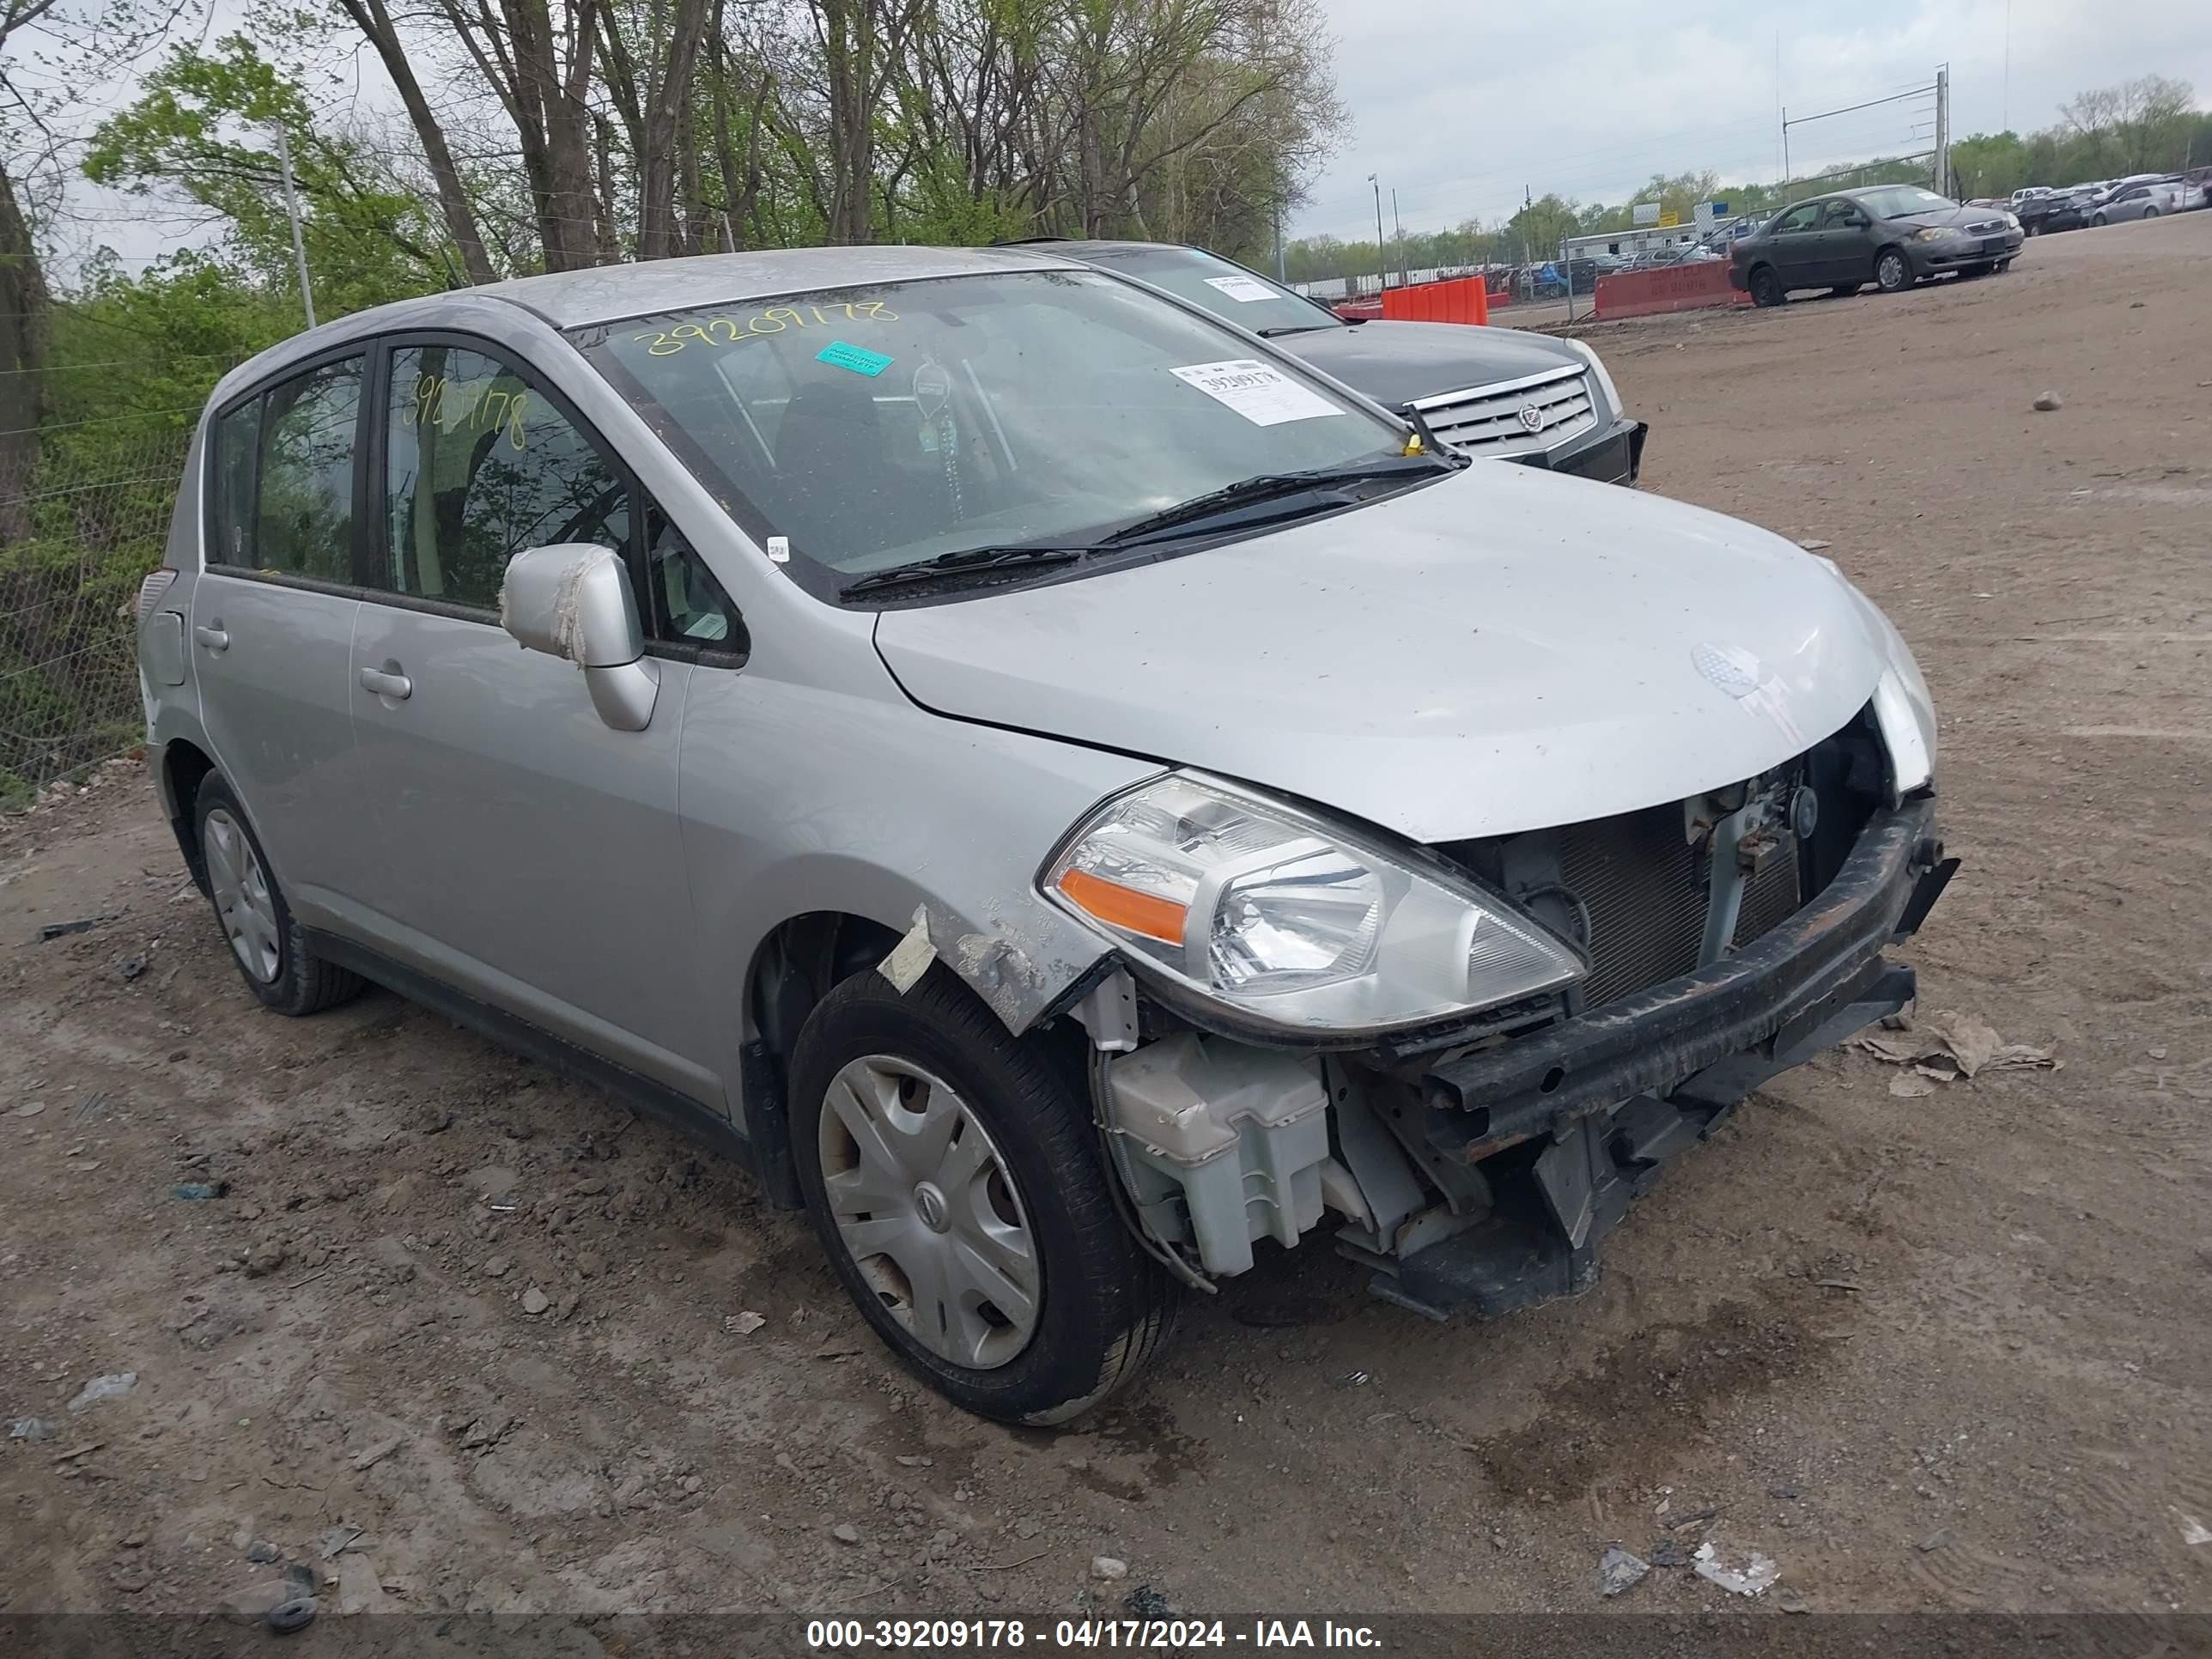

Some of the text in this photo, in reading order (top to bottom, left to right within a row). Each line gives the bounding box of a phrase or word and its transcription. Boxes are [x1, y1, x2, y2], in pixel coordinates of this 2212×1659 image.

[634, 301, 899, 356] 39209178
[829, 353, 876, 369] COMPLETE
[830, 348, 881, 366] INSPECTION
[1201, 371, 1282, 391] 39209178
[403, 370, 528, 451] 39209178
